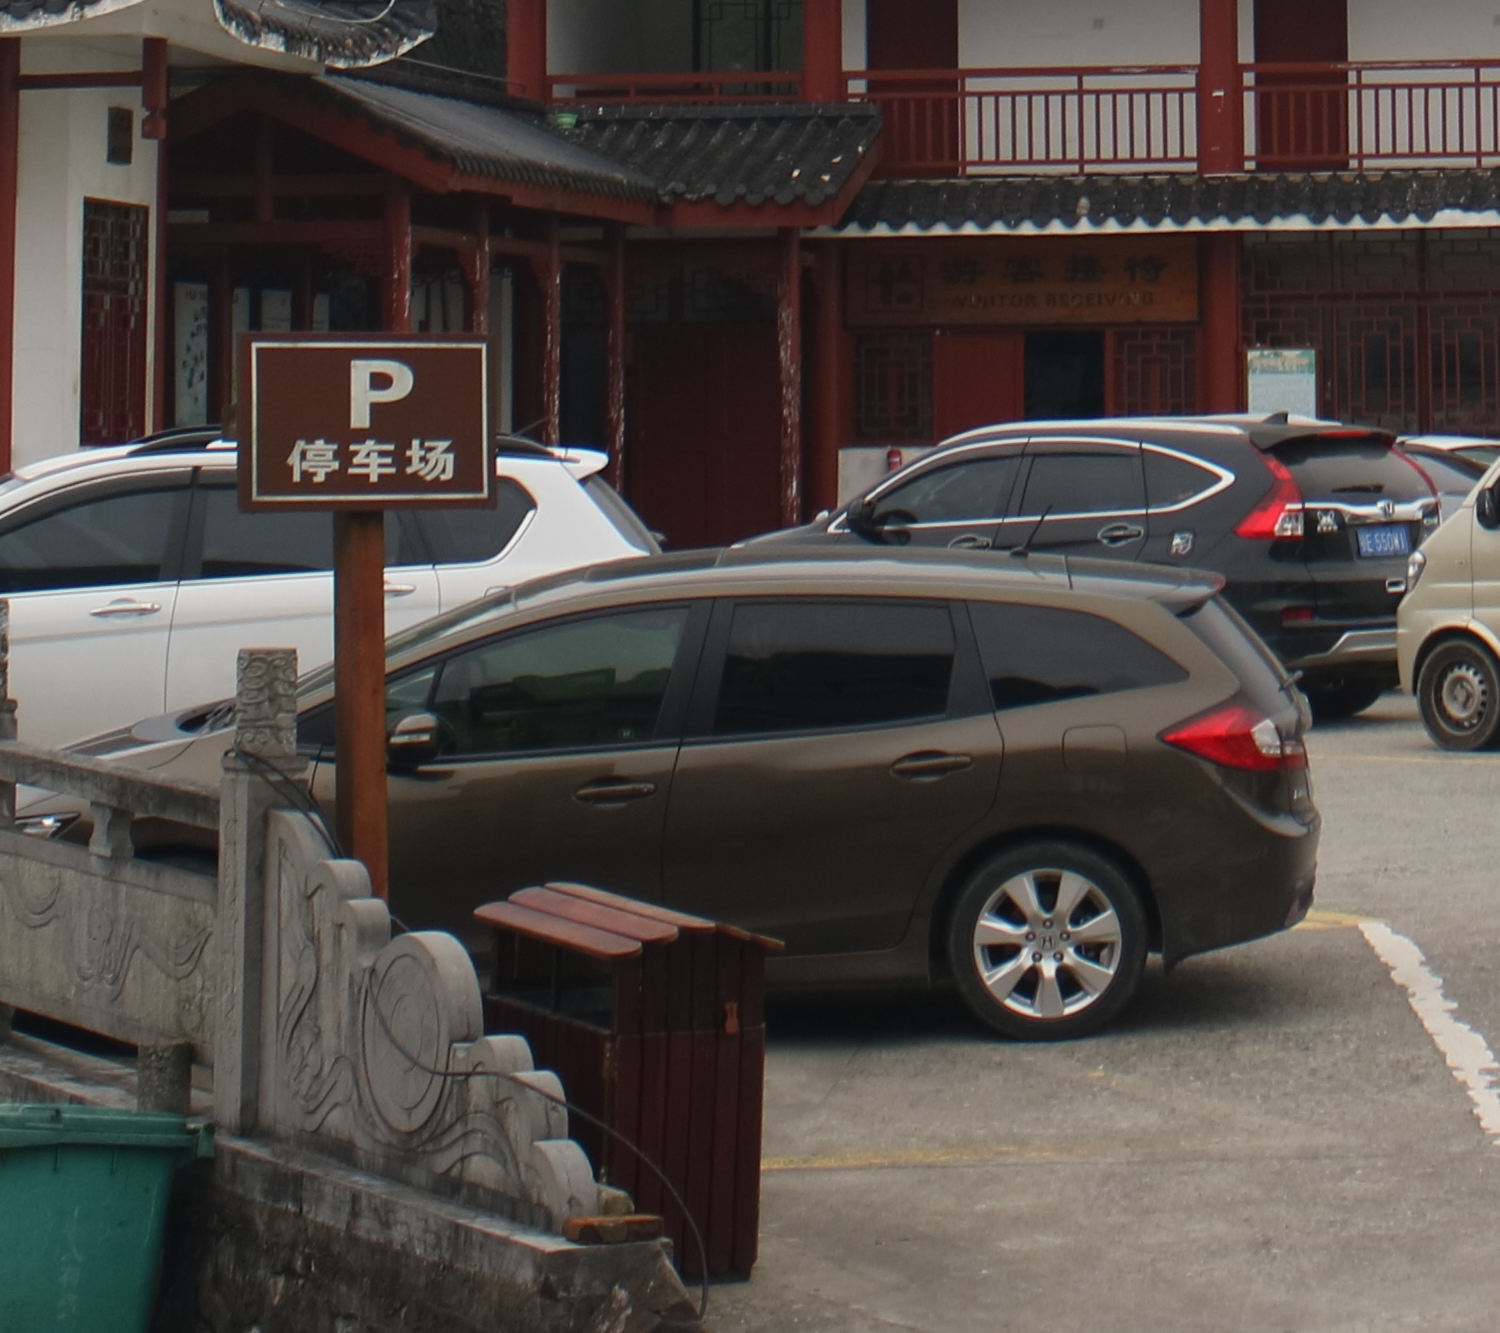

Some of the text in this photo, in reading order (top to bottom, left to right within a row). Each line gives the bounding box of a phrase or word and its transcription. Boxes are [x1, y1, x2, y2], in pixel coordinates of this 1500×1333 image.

[349, 359, 414, 430] P
[287, 439, 455, 483] 停车场
